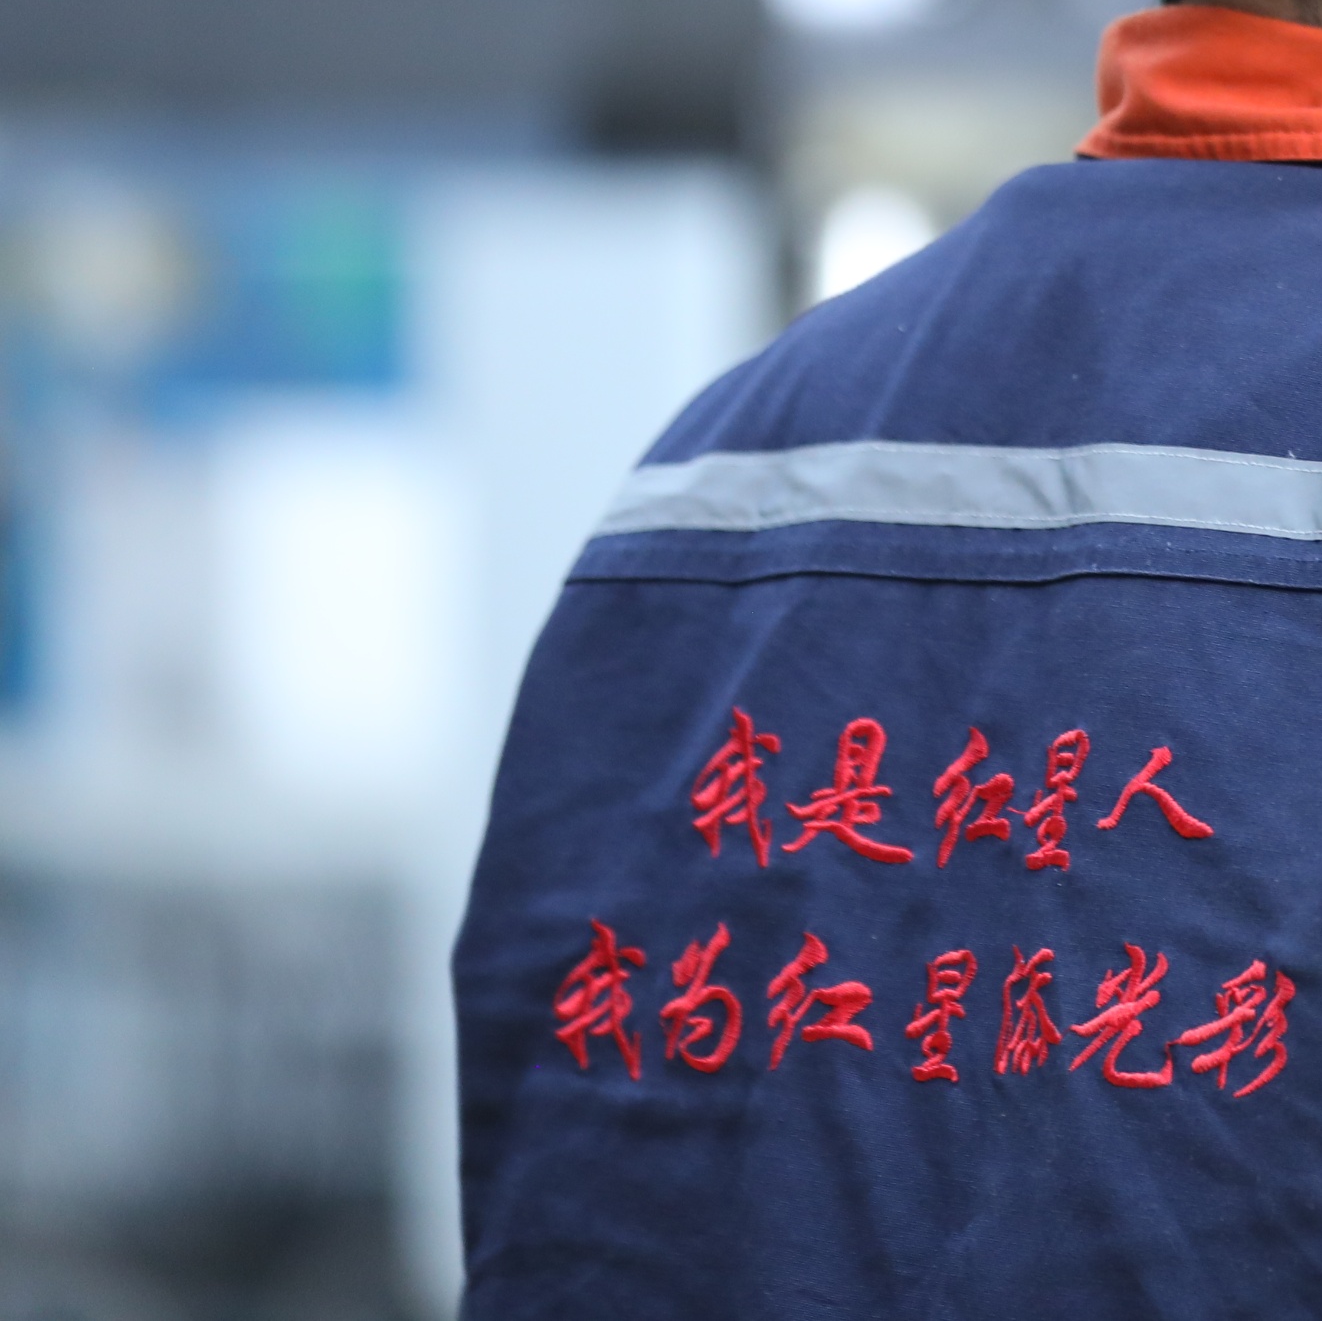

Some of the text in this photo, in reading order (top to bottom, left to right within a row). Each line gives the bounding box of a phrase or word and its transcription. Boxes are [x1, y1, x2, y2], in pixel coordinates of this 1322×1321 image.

[692, 709, 1213, 870] 我是红星人
[555, 921, 1296, 1098] 我为红星添光彩
